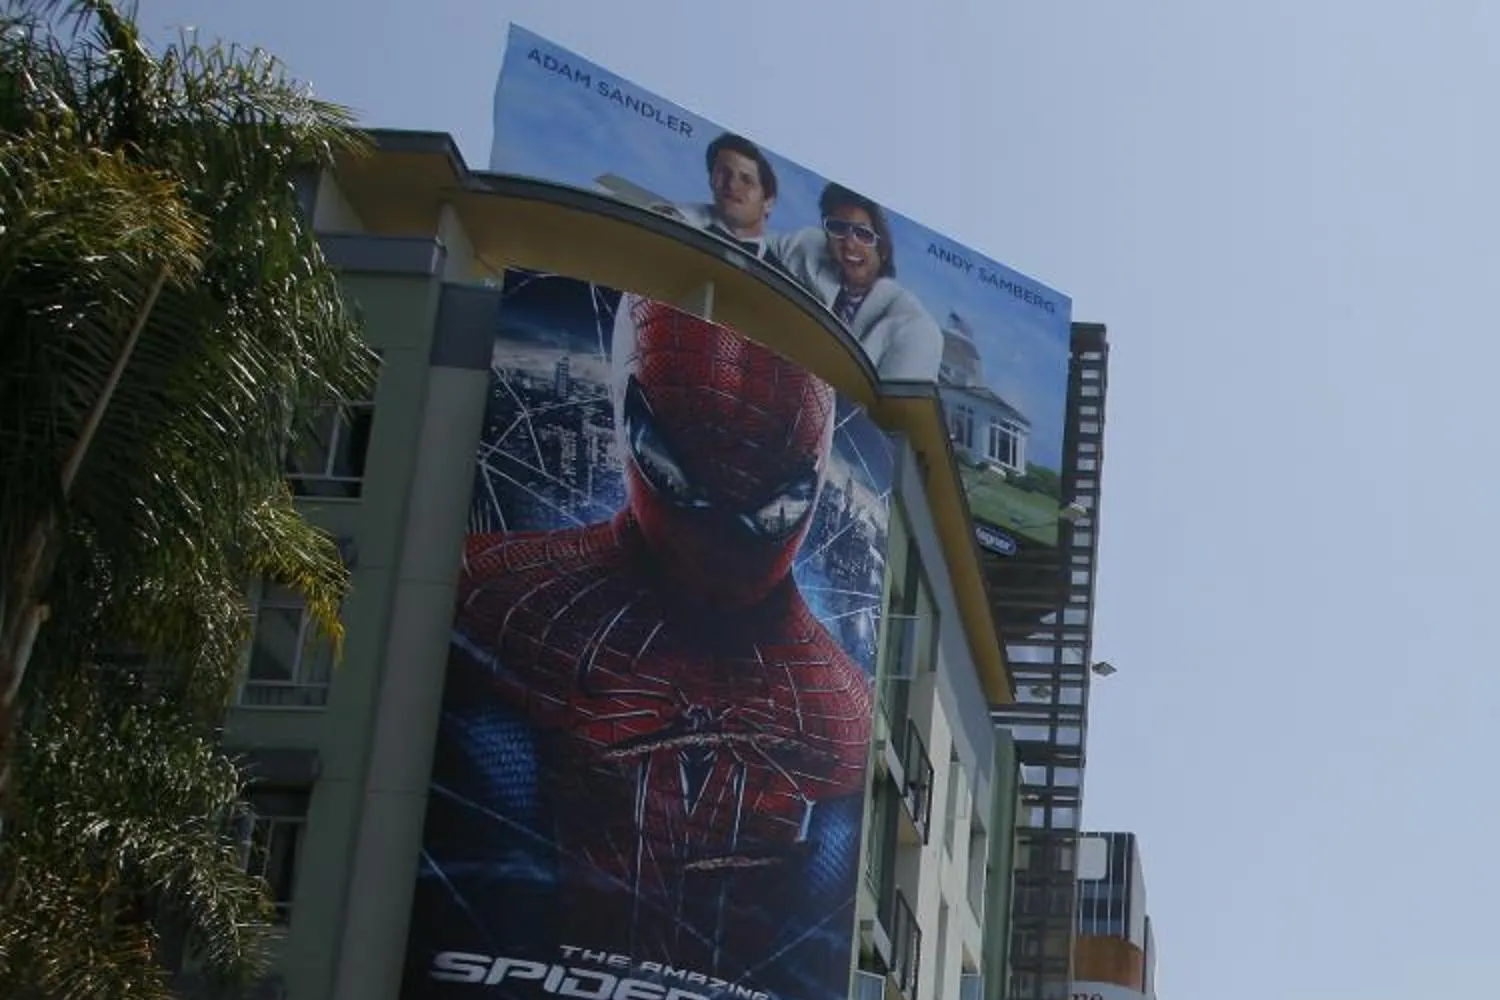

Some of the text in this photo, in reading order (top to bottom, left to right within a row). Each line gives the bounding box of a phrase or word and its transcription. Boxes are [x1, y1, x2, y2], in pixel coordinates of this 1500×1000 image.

[527, 48, 694, 138] ADAM SANDLER
[927, 243, 1056, 314] ANDY SAMBERG
[559, 944, 632, 969] THE
